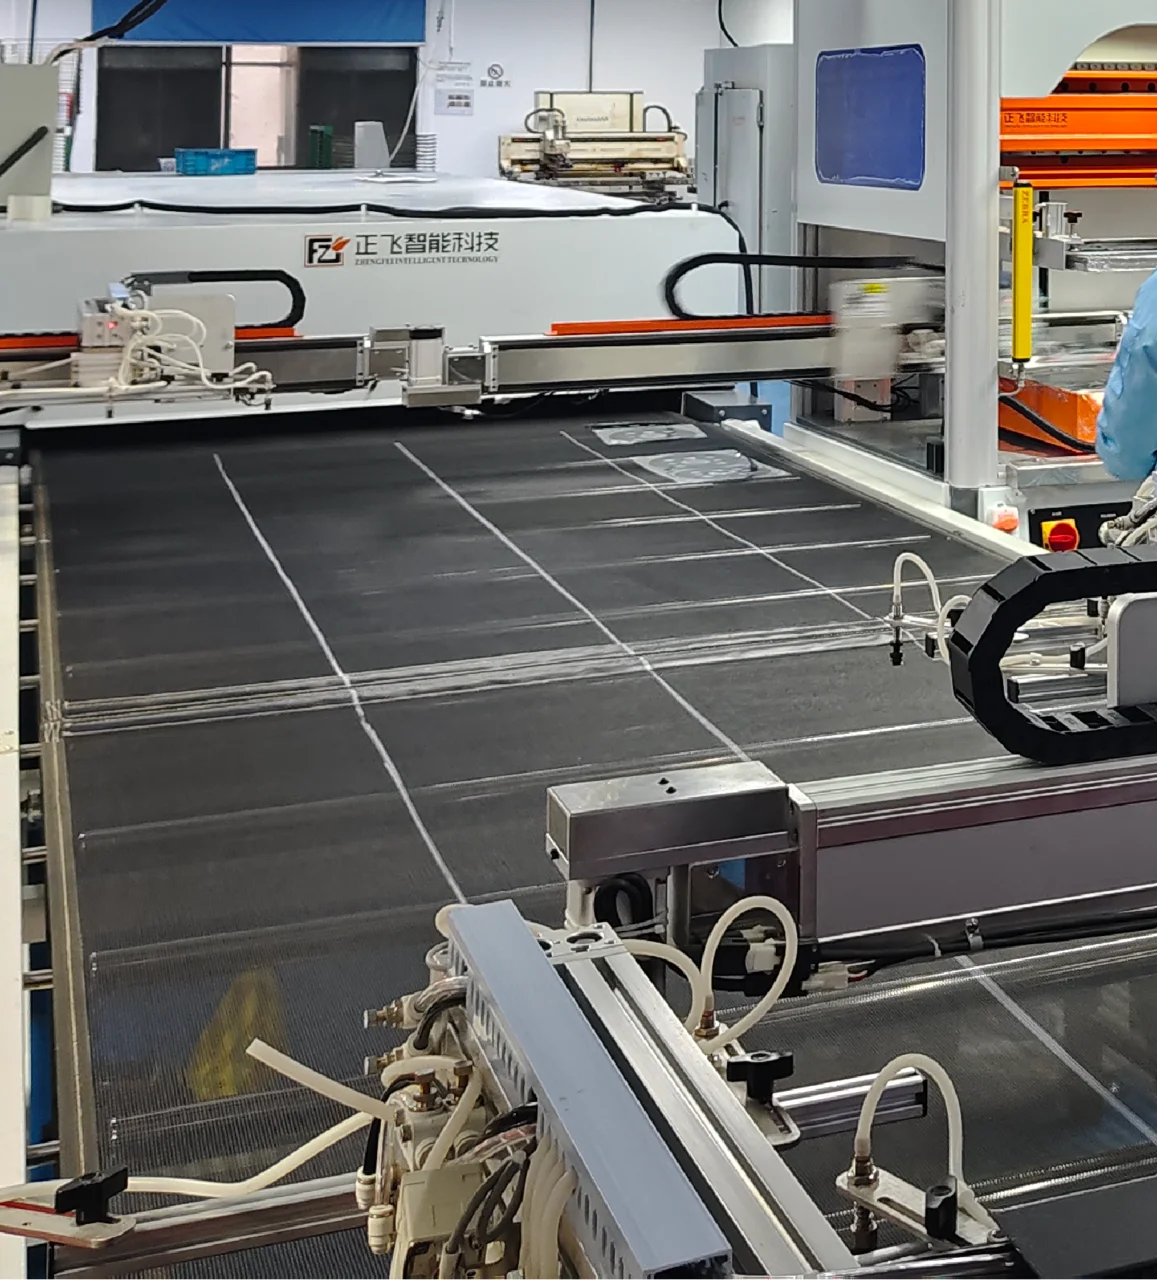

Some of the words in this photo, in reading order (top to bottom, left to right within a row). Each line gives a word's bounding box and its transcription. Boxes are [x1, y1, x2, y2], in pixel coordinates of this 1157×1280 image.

[1021, 189, 1030, 224] ZEBRA
[354, 231, 500, 256] 正飞智能科技
[447, 255, 499, 264] TECHNOLOGY
